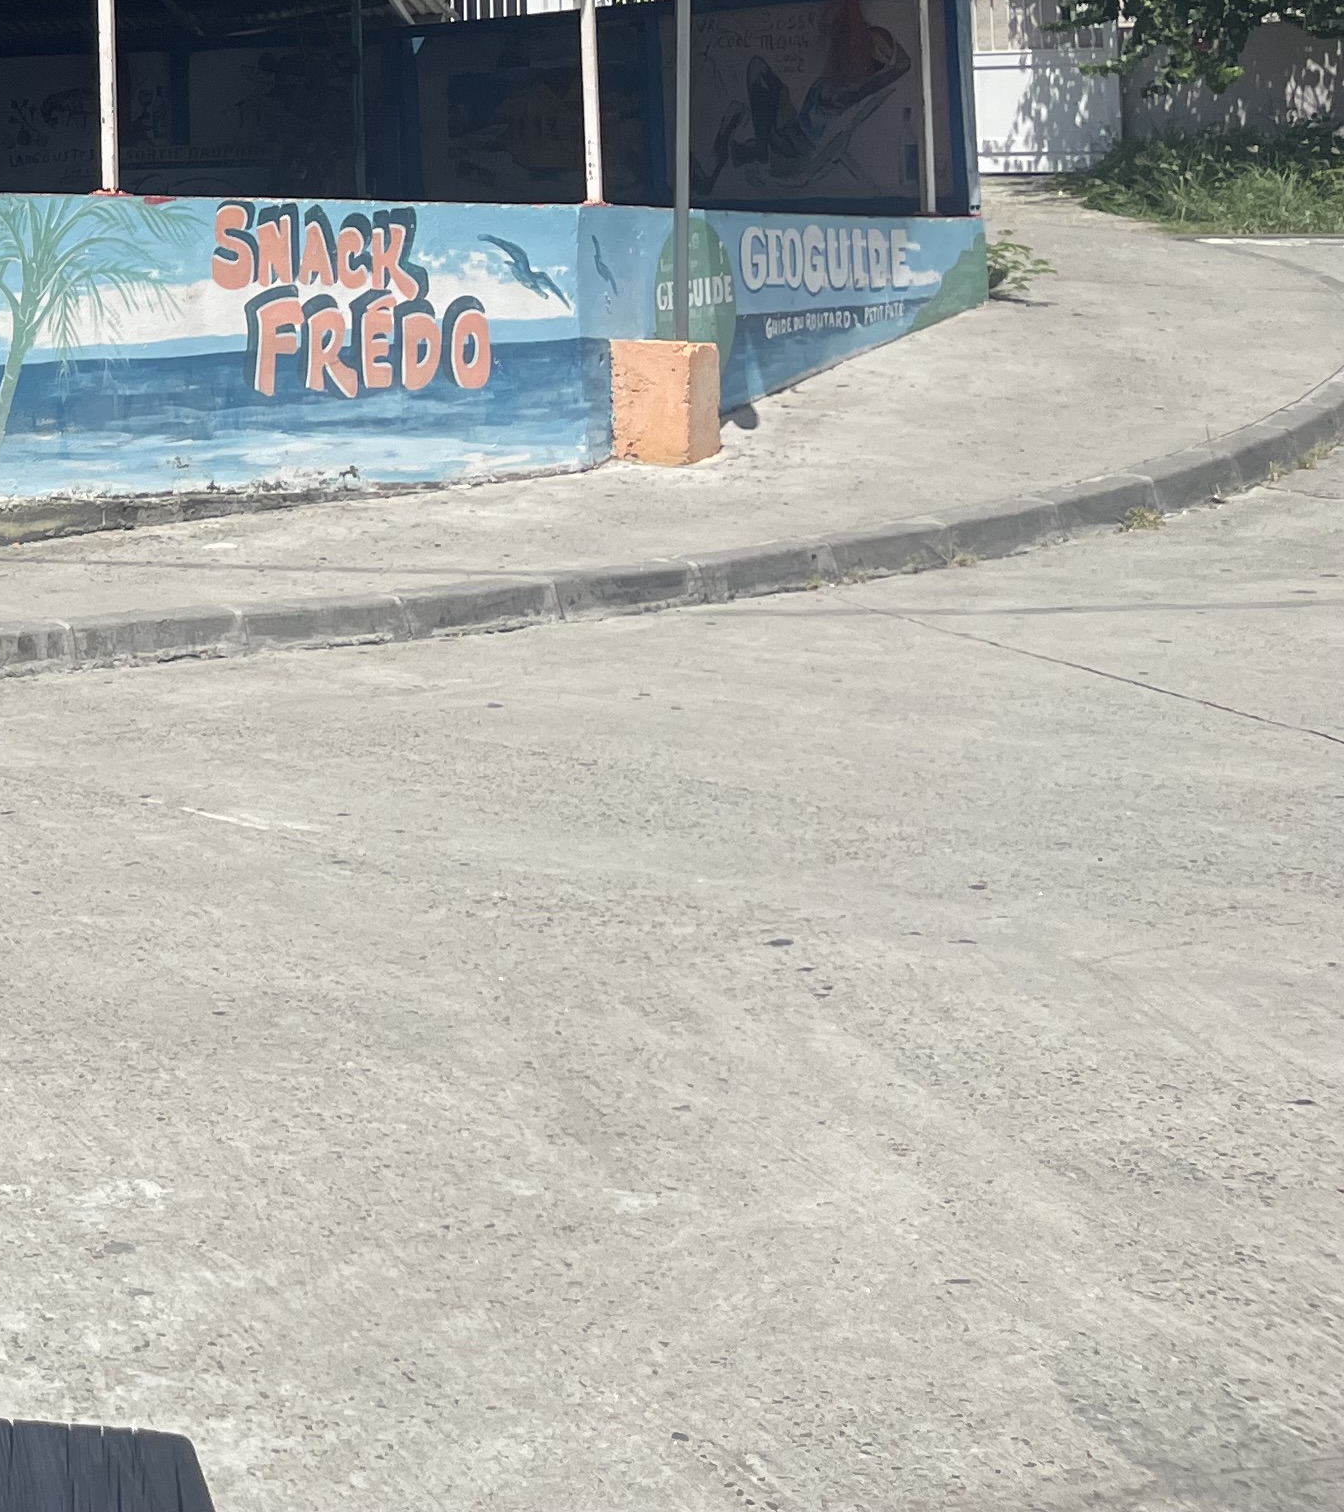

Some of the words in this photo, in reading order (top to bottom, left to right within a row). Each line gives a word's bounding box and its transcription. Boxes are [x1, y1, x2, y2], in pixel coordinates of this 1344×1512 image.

[211, 200, 429, 301] SNACK
[765, 316, 792, 339] GUIDE
[806, 310, 852, 332] ROUTARD
